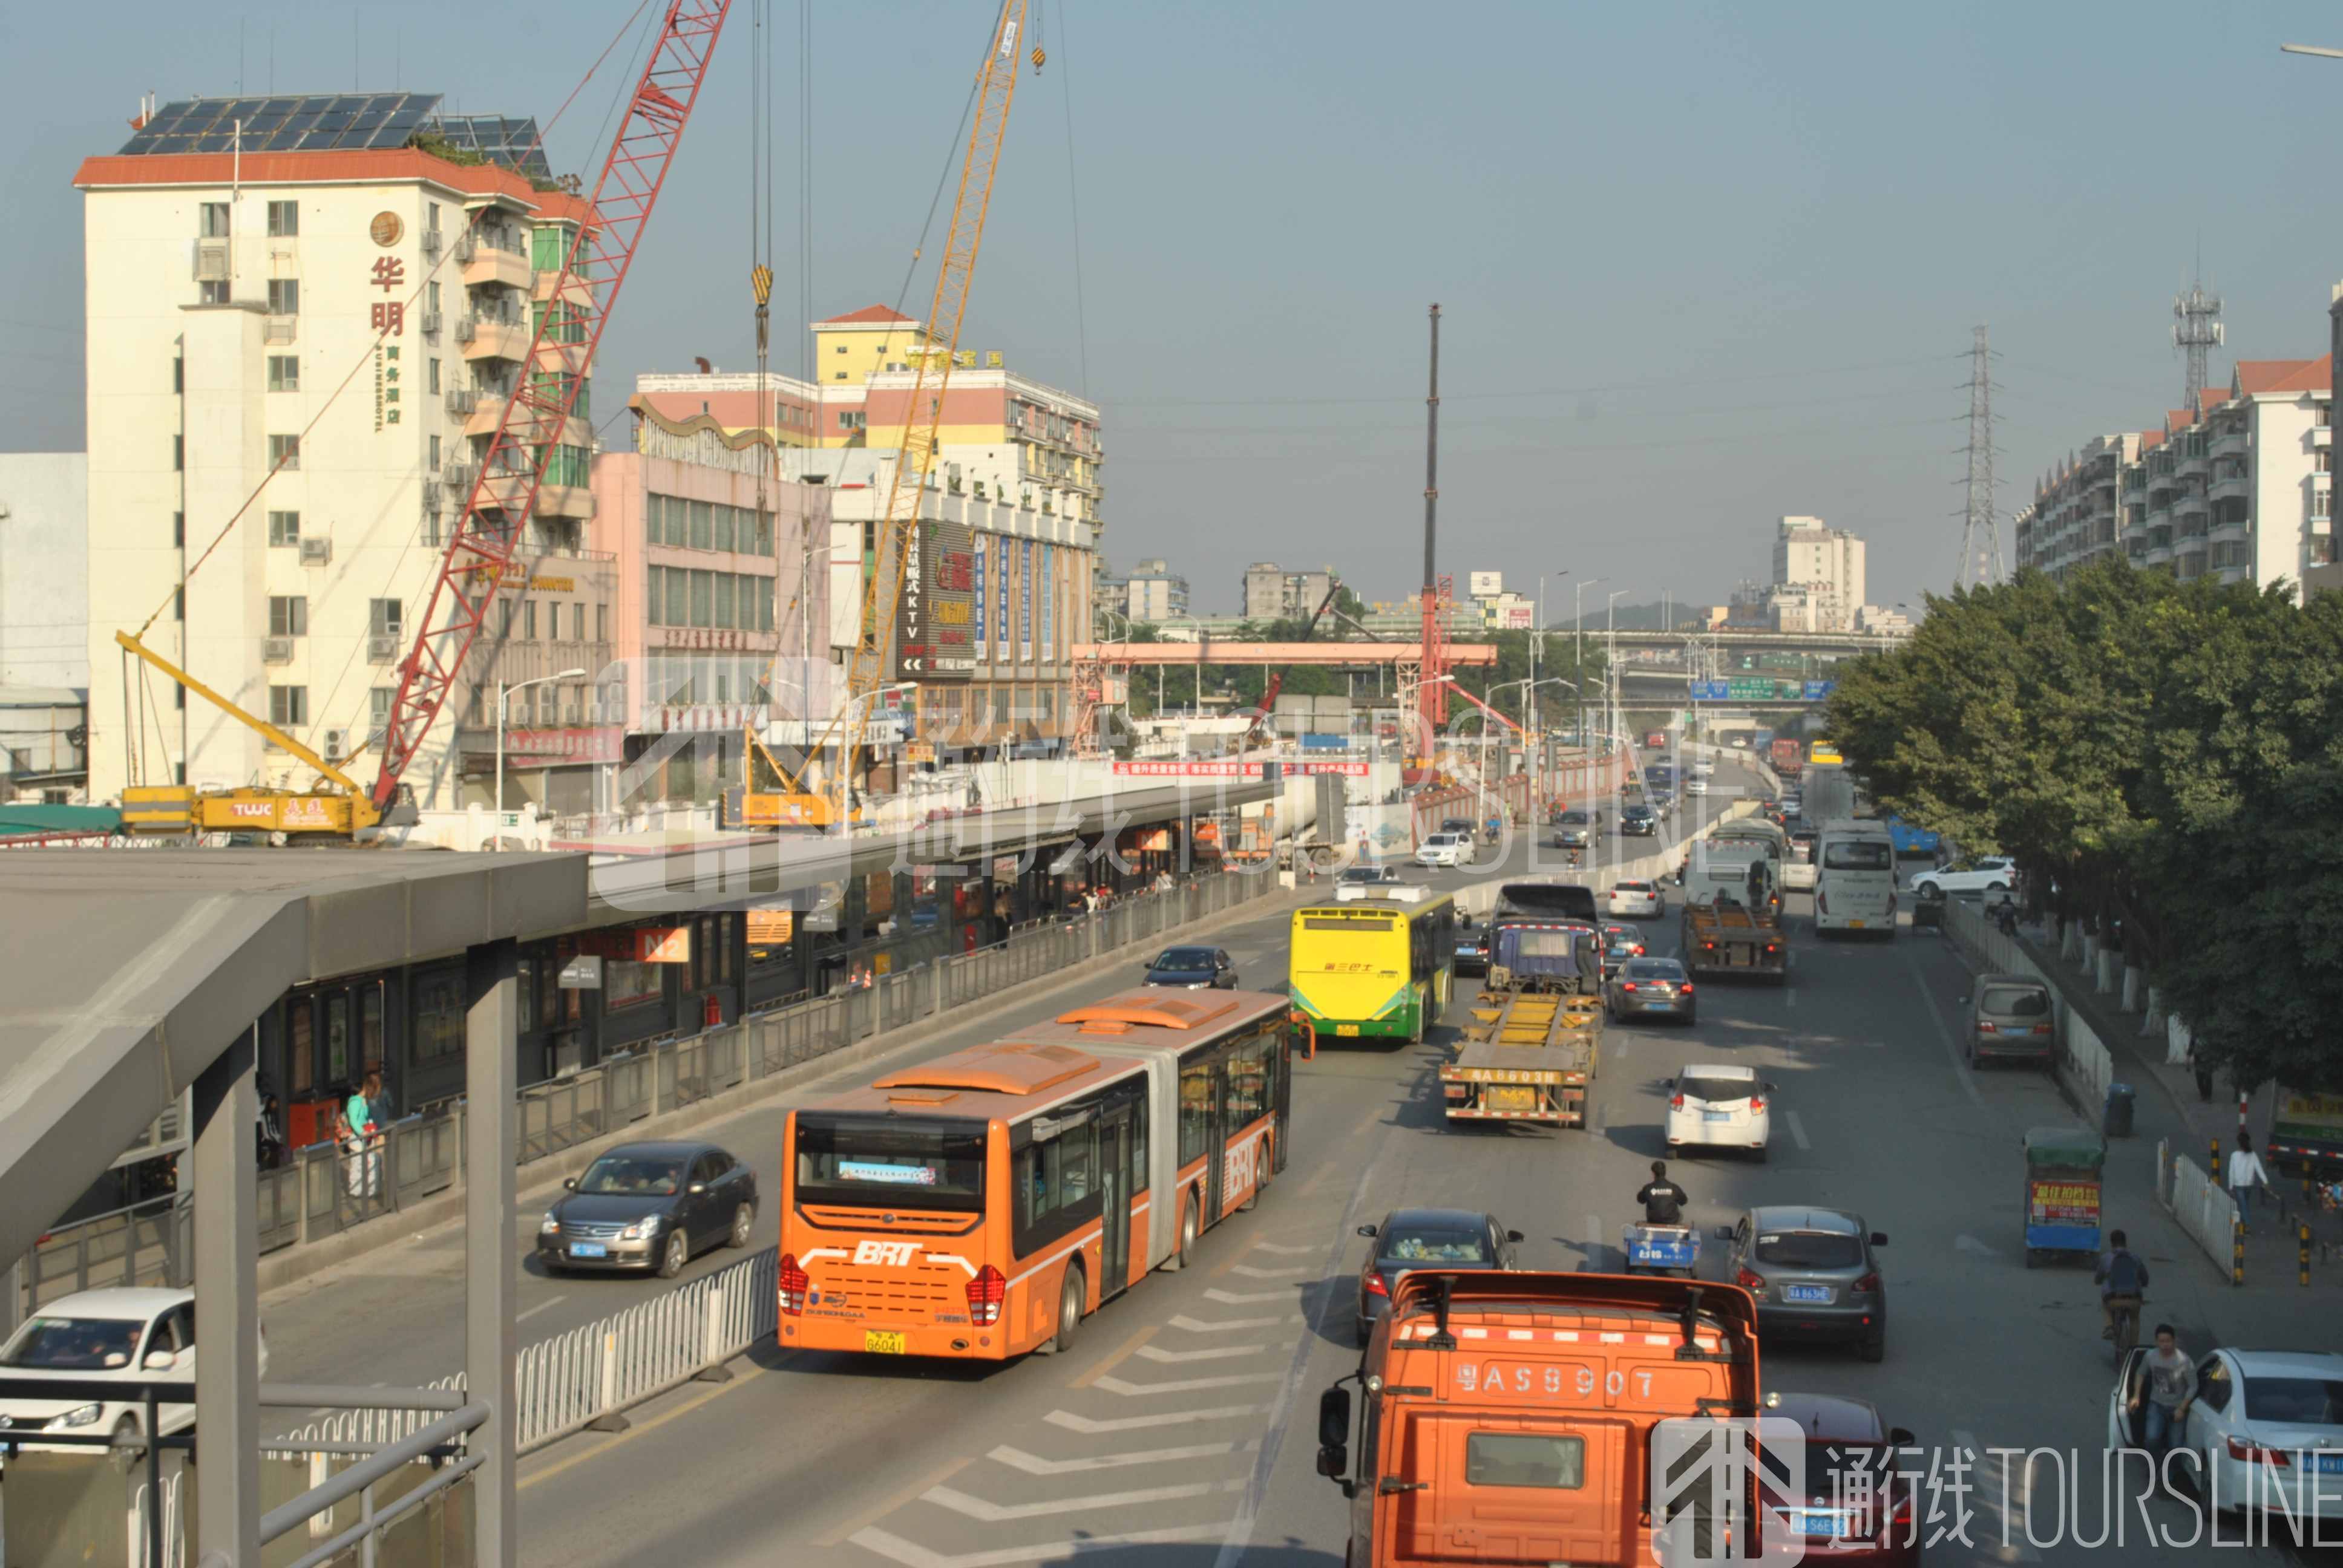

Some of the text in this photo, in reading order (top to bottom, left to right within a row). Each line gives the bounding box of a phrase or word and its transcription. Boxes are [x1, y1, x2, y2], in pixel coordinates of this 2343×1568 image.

[370, 256, 405, 337] 华明
[386, 345, 401, 424] 商务酒店
[644, 934, 680, 958] N2
[1228, 1135, 1257, 1199] BRT
[852, 1240, 923, 1267] BRT
[867, 1339, 901, 1353] G6041
